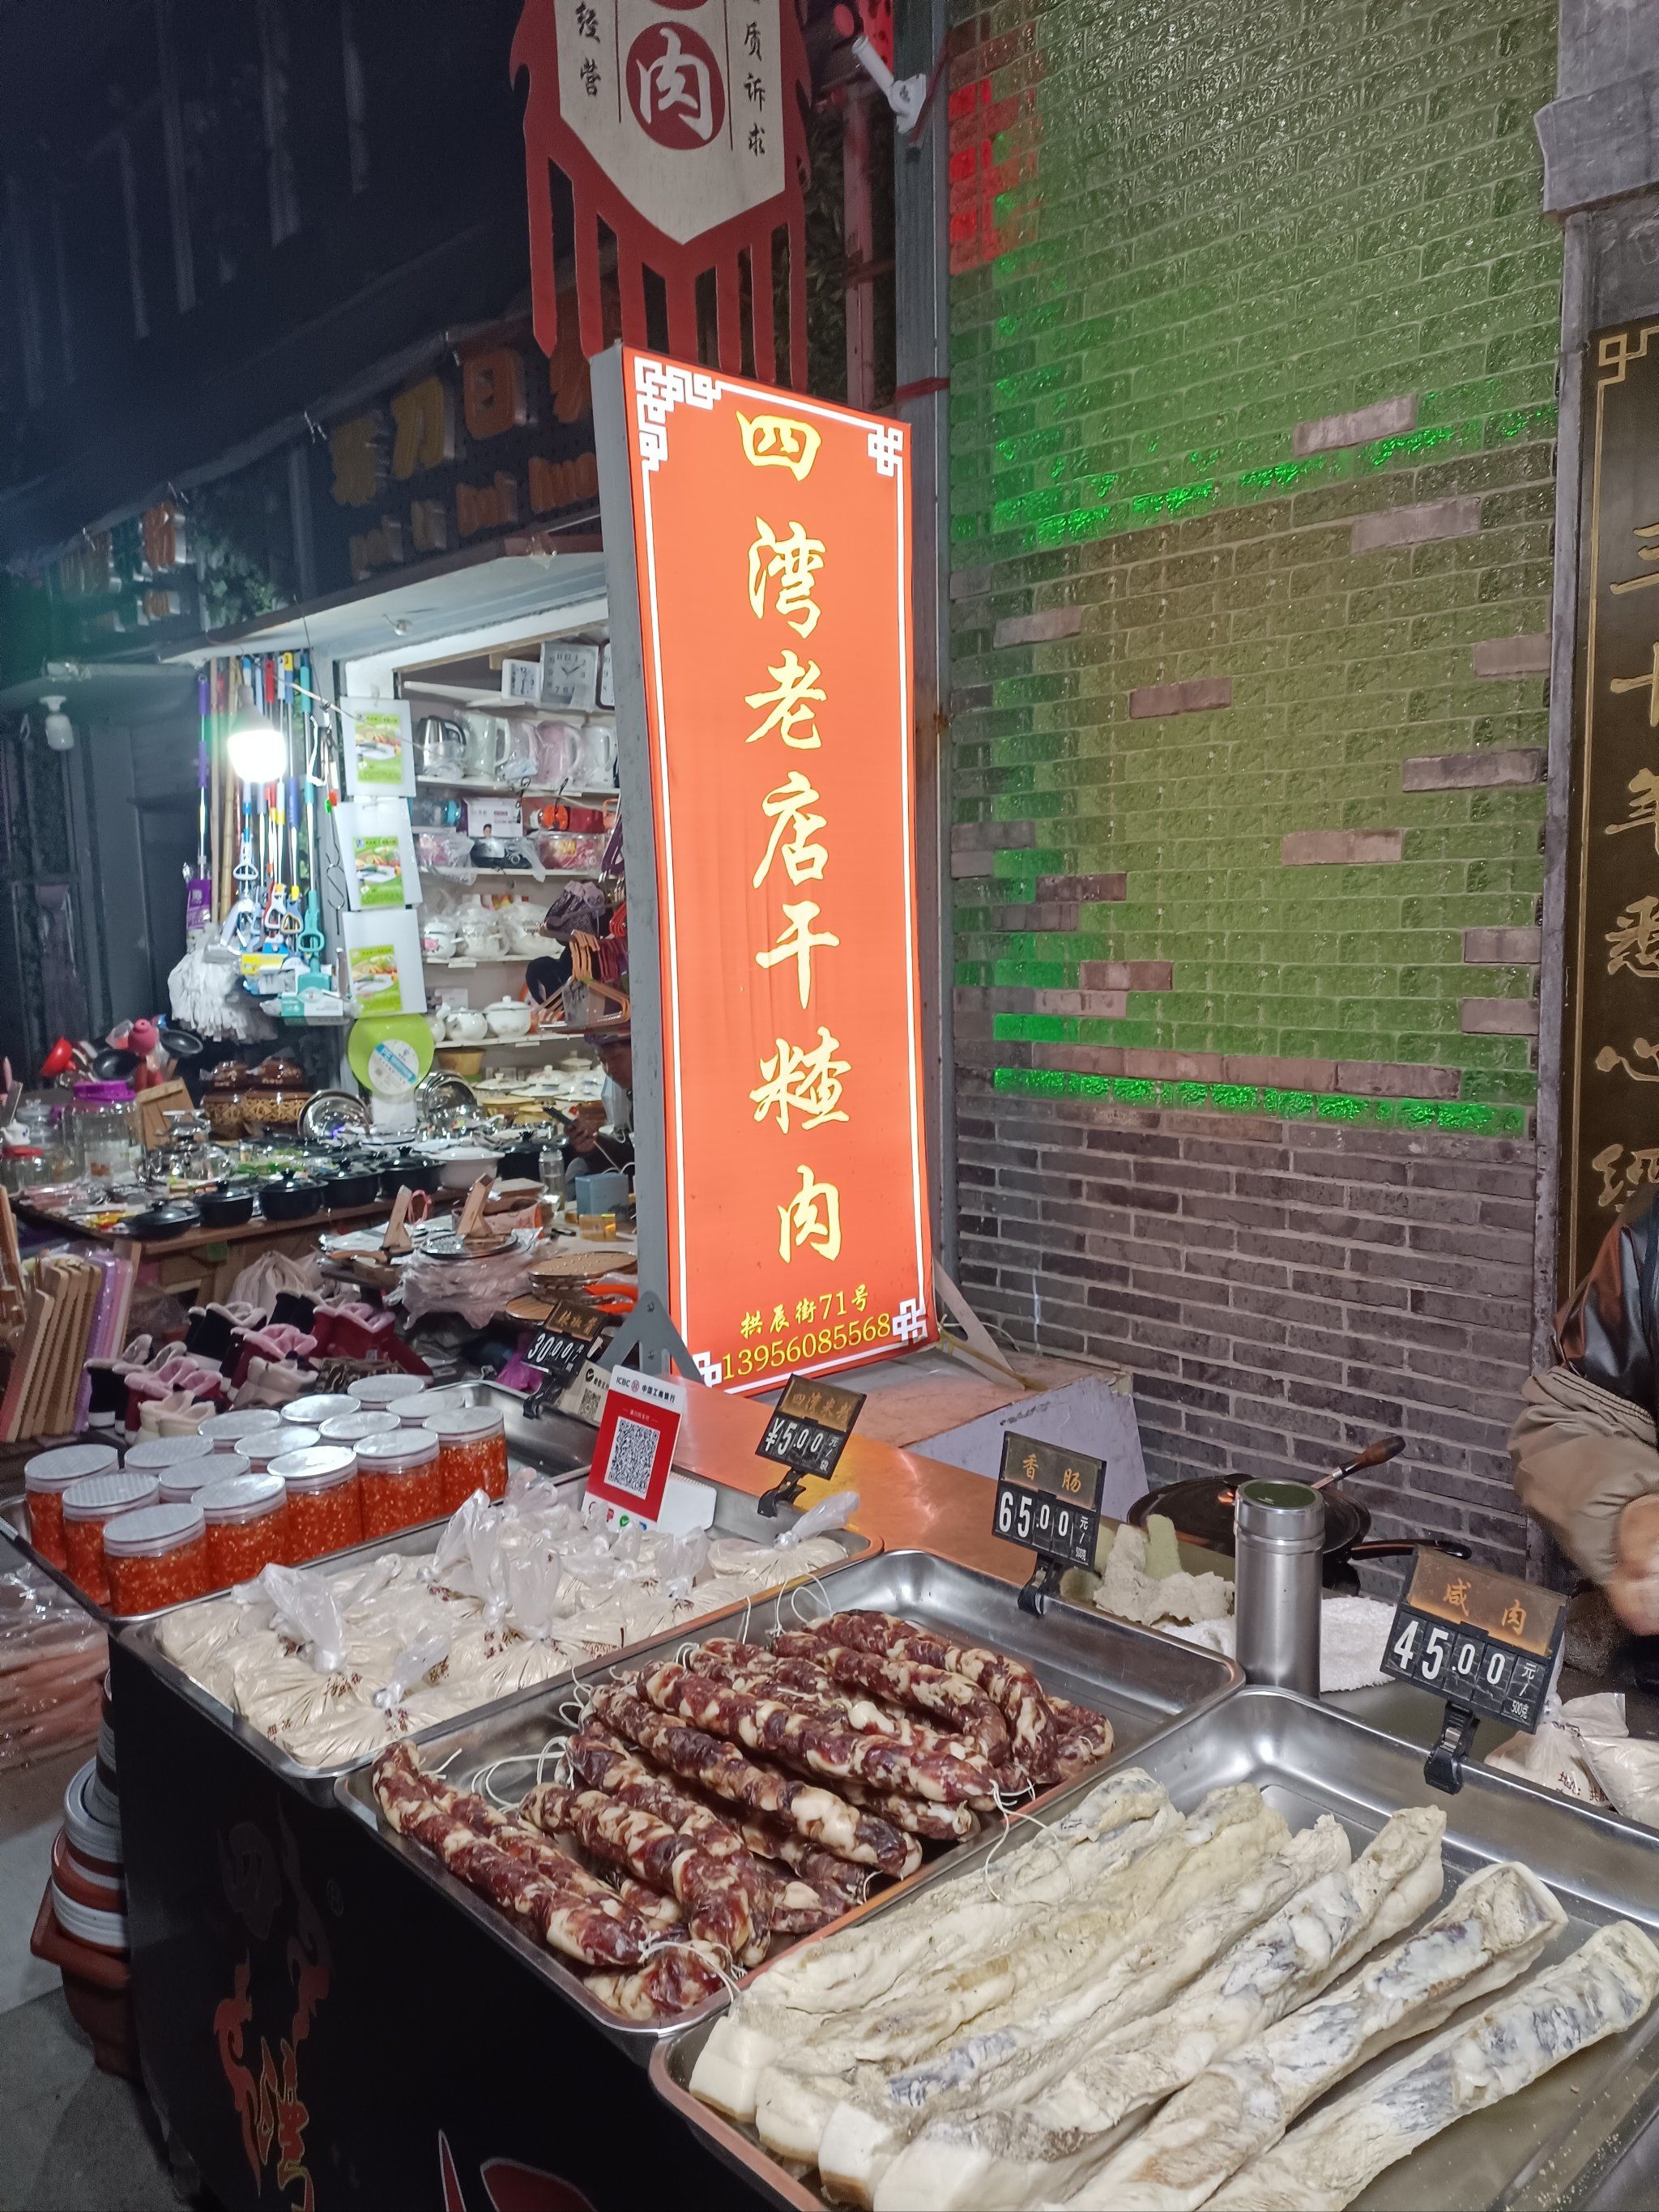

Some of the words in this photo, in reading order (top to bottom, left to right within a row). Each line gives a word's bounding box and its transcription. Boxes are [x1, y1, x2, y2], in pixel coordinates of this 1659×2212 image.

[635, 27, 714, 141] 肉
[744, 0, 766, 156] 质诉求
[740, 1284, 869, 1339] 拱辰街71号
[527, 1332, 574, 1363] 30.00
[722, 1313, 891, 1380] 13956085568
[616, 1377, 631, 1388] ICBC
[642, 1384, 676, 1404] 中国工商银行
[1022, 1453, 1081, 1493] 香肠
[999, 1491, 1069, 1538] 65.00
[1443, 1578, 1527, 1636] 咸肉
[1393, 1620, 1506, 1686] 45.00
